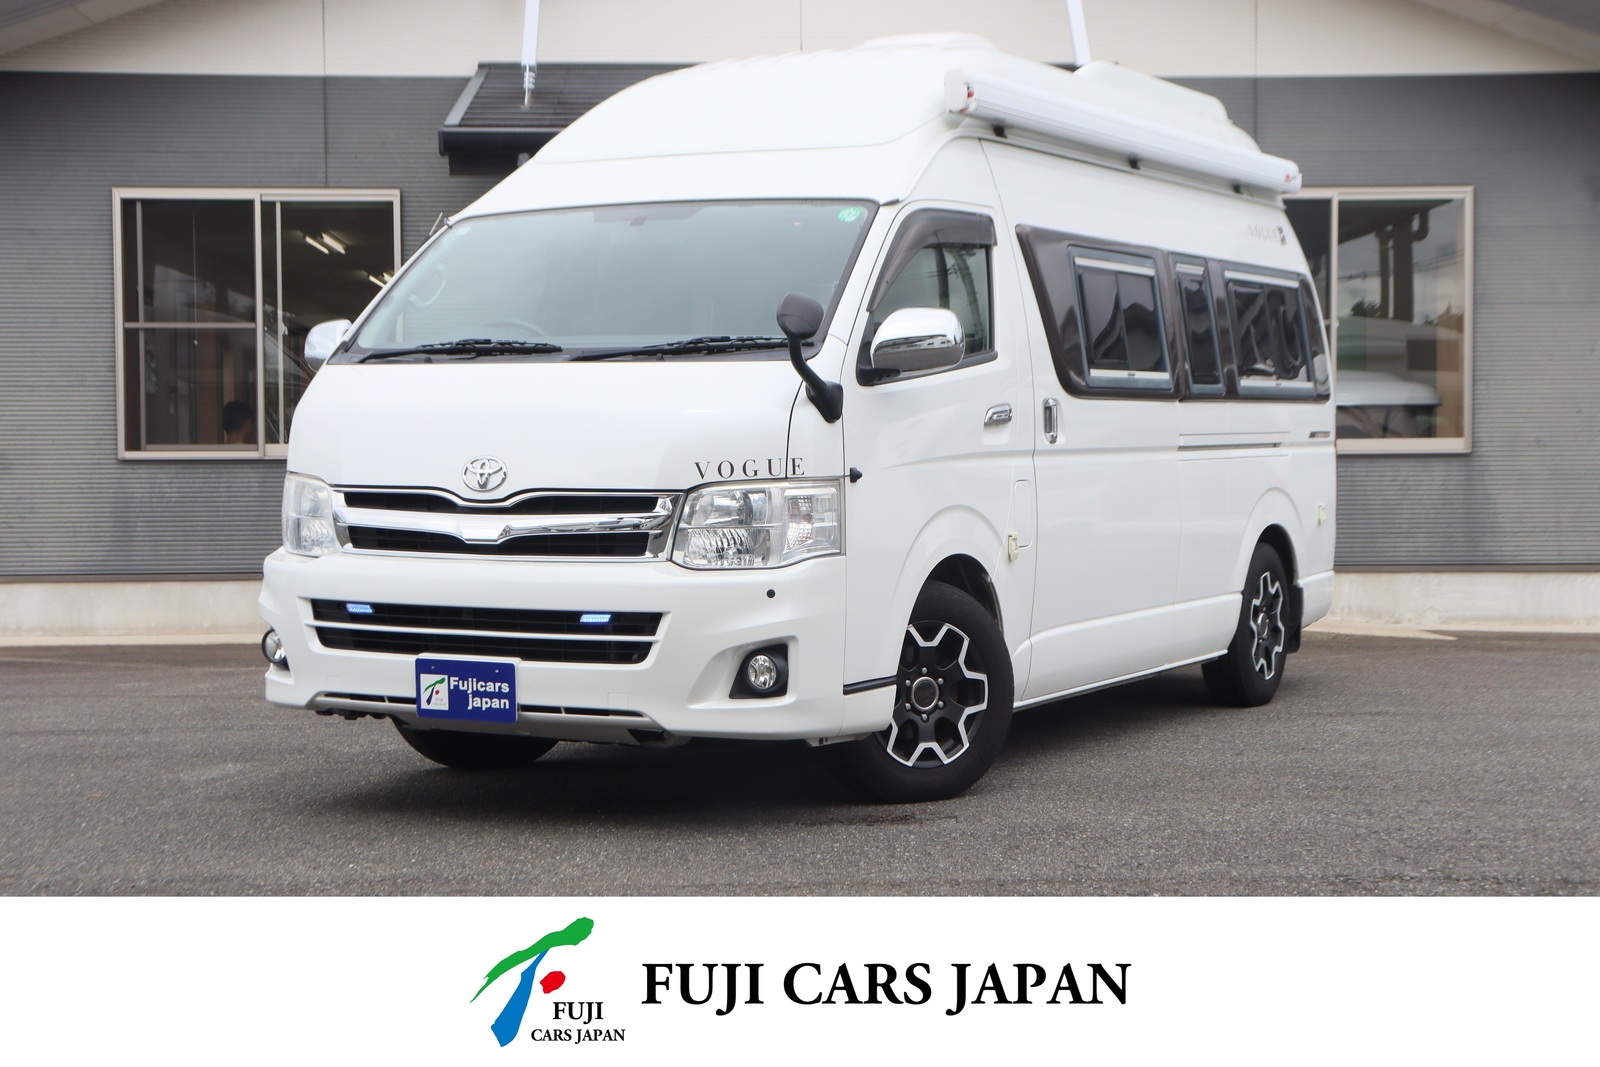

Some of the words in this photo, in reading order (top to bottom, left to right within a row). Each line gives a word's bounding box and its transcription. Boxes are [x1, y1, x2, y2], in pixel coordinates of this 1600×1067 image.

[693, 457, 805, 480] VOGUE
[449, 676, 510, 694] Fujicars
[467, 694, 510, 710] japan
